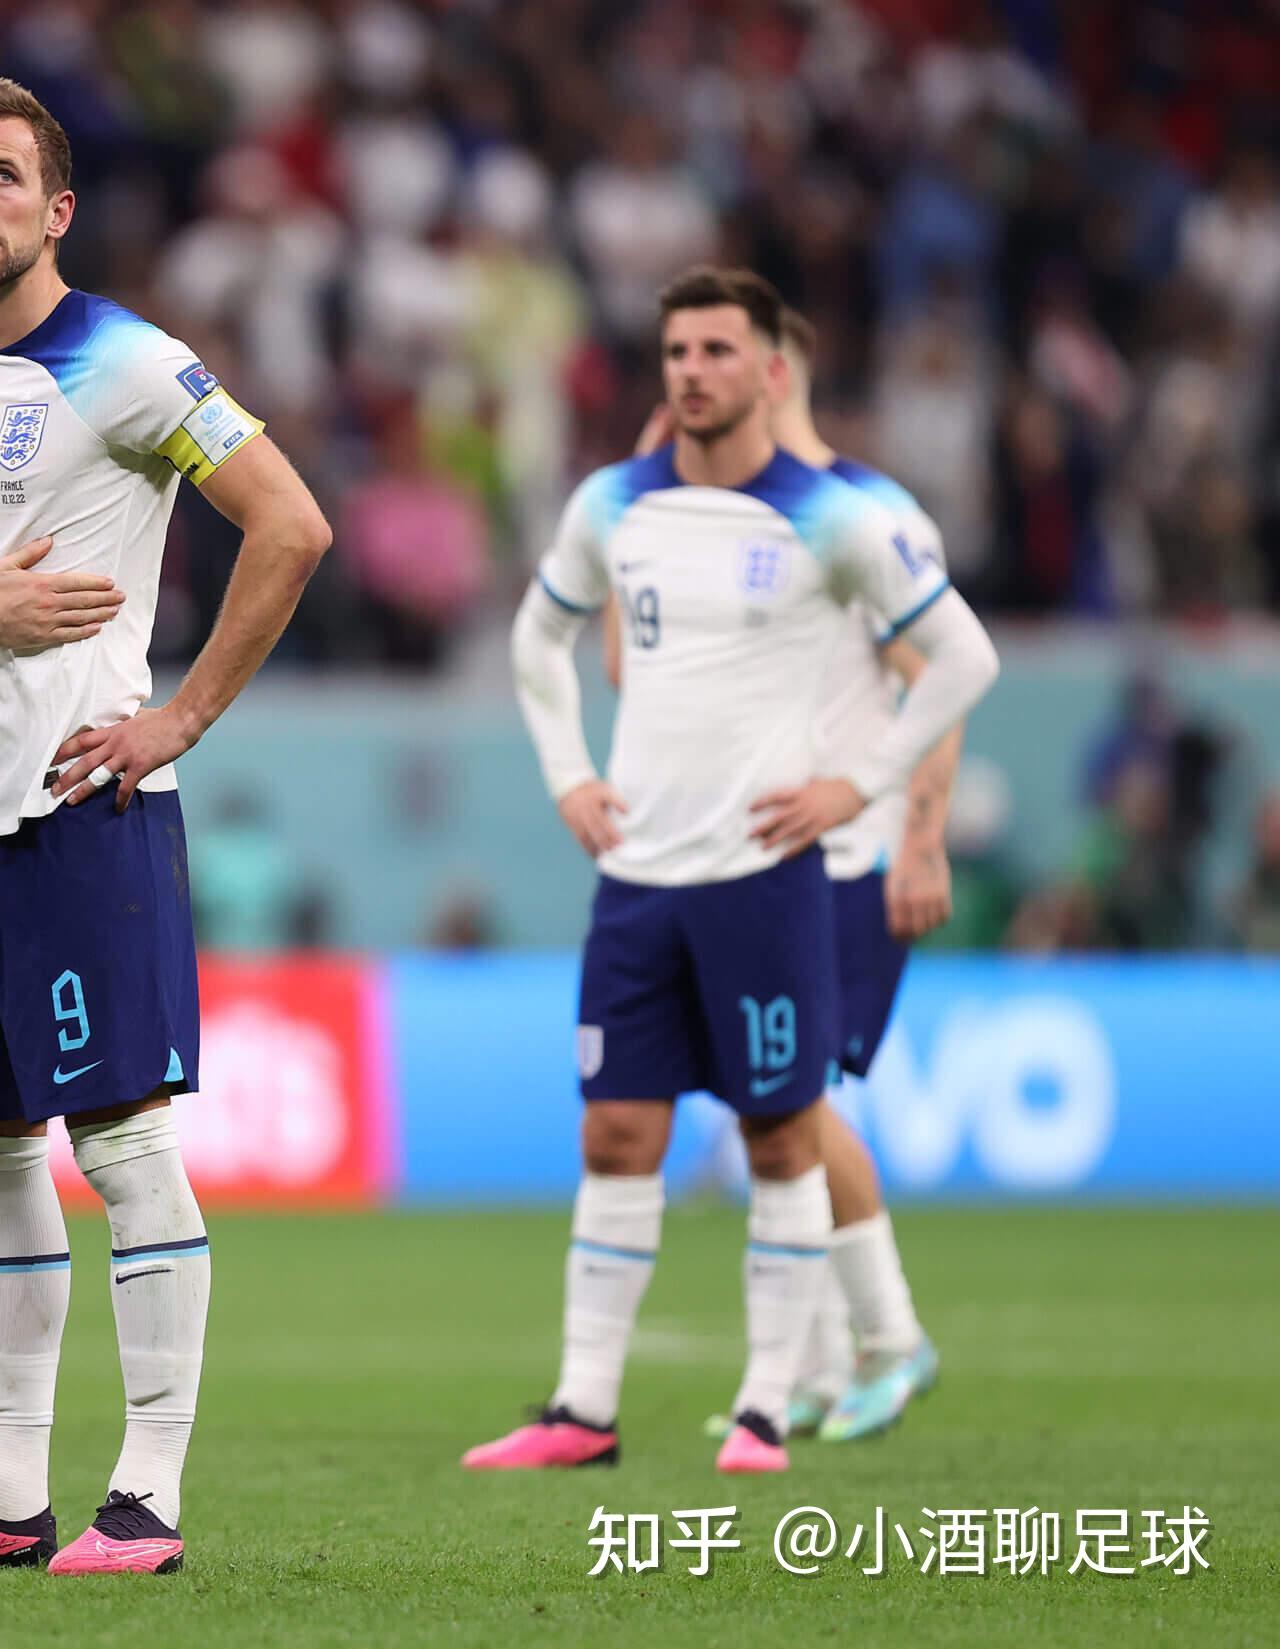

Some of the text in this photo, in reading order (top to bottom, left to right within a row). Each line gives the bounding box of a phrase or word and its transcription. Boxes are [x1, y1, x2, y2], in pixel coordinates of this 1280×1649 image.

[0, 480, 25, 491] FRANCE
[51, 968, 90, 1052] 9
[740, 995, 796, 1069] 19
